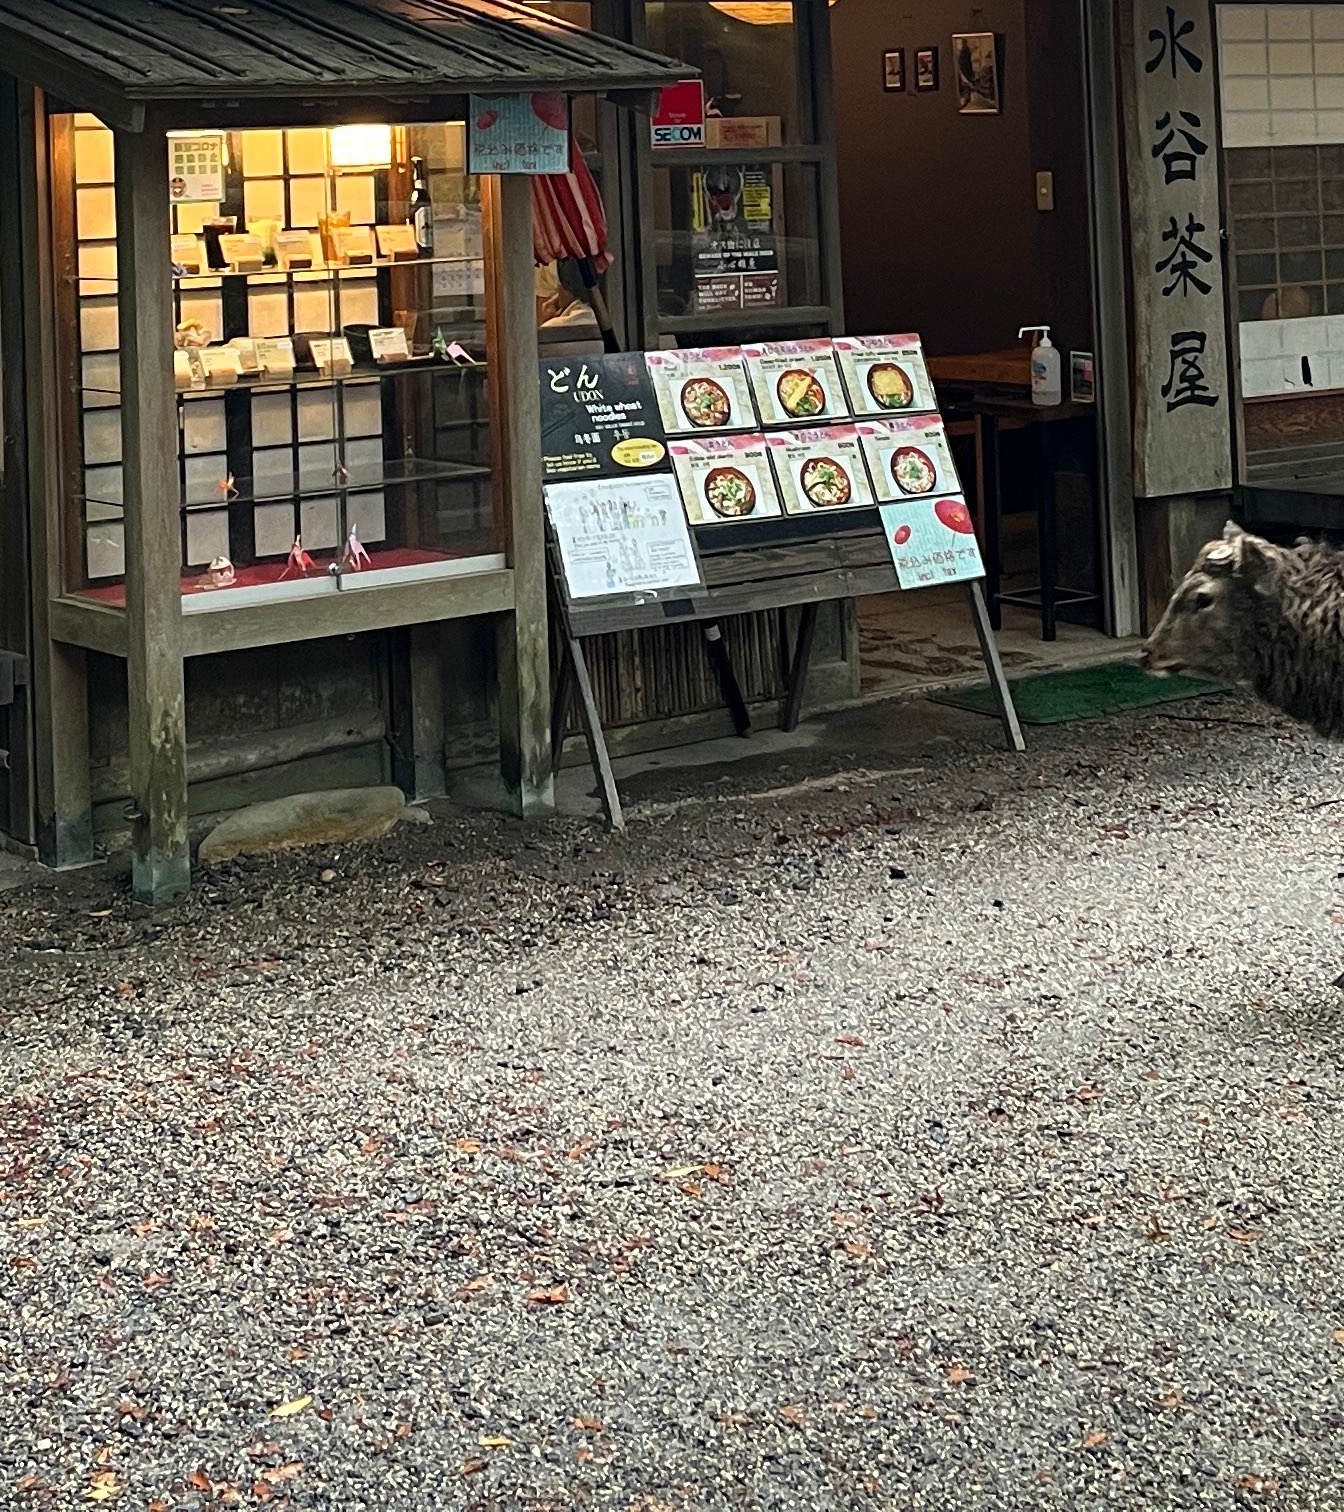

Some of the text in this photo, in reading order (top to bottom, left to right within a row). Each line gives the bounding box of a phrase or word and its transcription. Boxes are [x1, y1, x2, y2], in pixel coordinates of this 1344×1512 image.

[654, 126, 702, 142] SECOM
[1144, 5, 1220, 414] 水谷茶屋
[585, 400, 643, 415] White wheat
[591, 412, 627, 424] noodles
